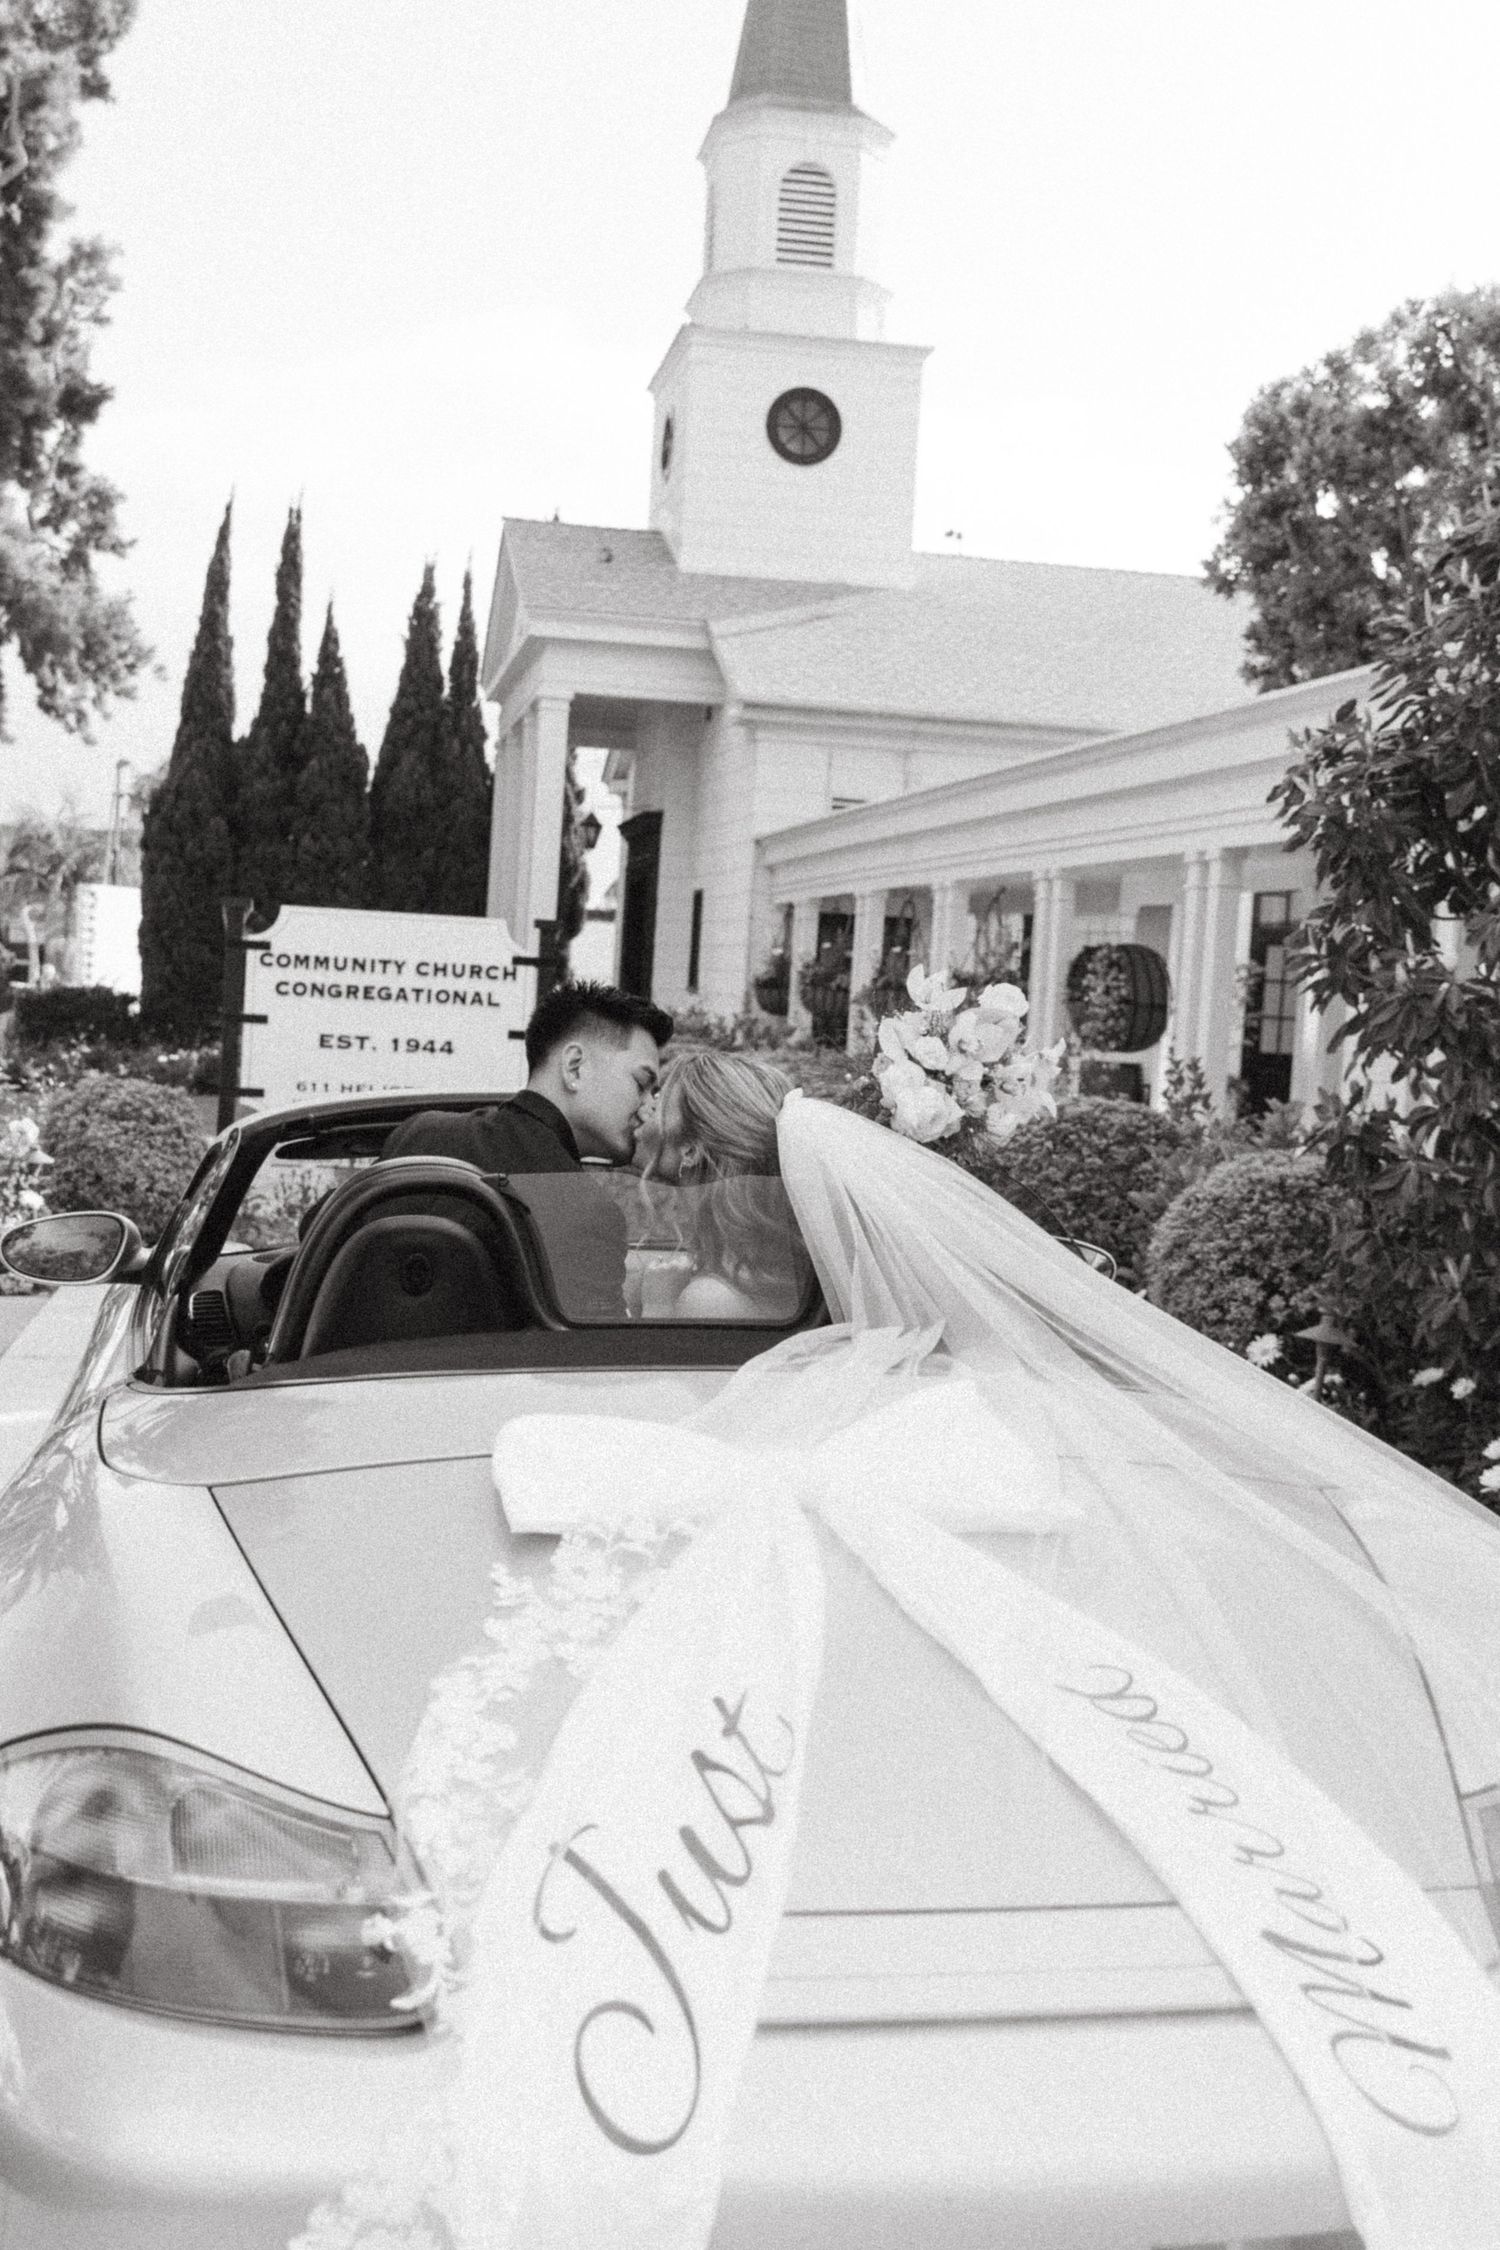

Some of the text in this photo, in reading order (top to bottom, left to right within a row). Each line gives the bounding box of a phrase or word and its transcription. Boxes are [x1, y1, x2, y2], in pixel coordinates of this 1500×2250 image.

[259, 952, 517, 981] COMMUNITY CHURCH
[274, 981, 500, 1007] CONGREGATIONAL
[319, 1033, 454, 1055] EST. 1944
[296, 1081, 330, 1093] 611
[1054, 1663, 1460, 2138] Married
[533, 1690, 795, 2155] Just
